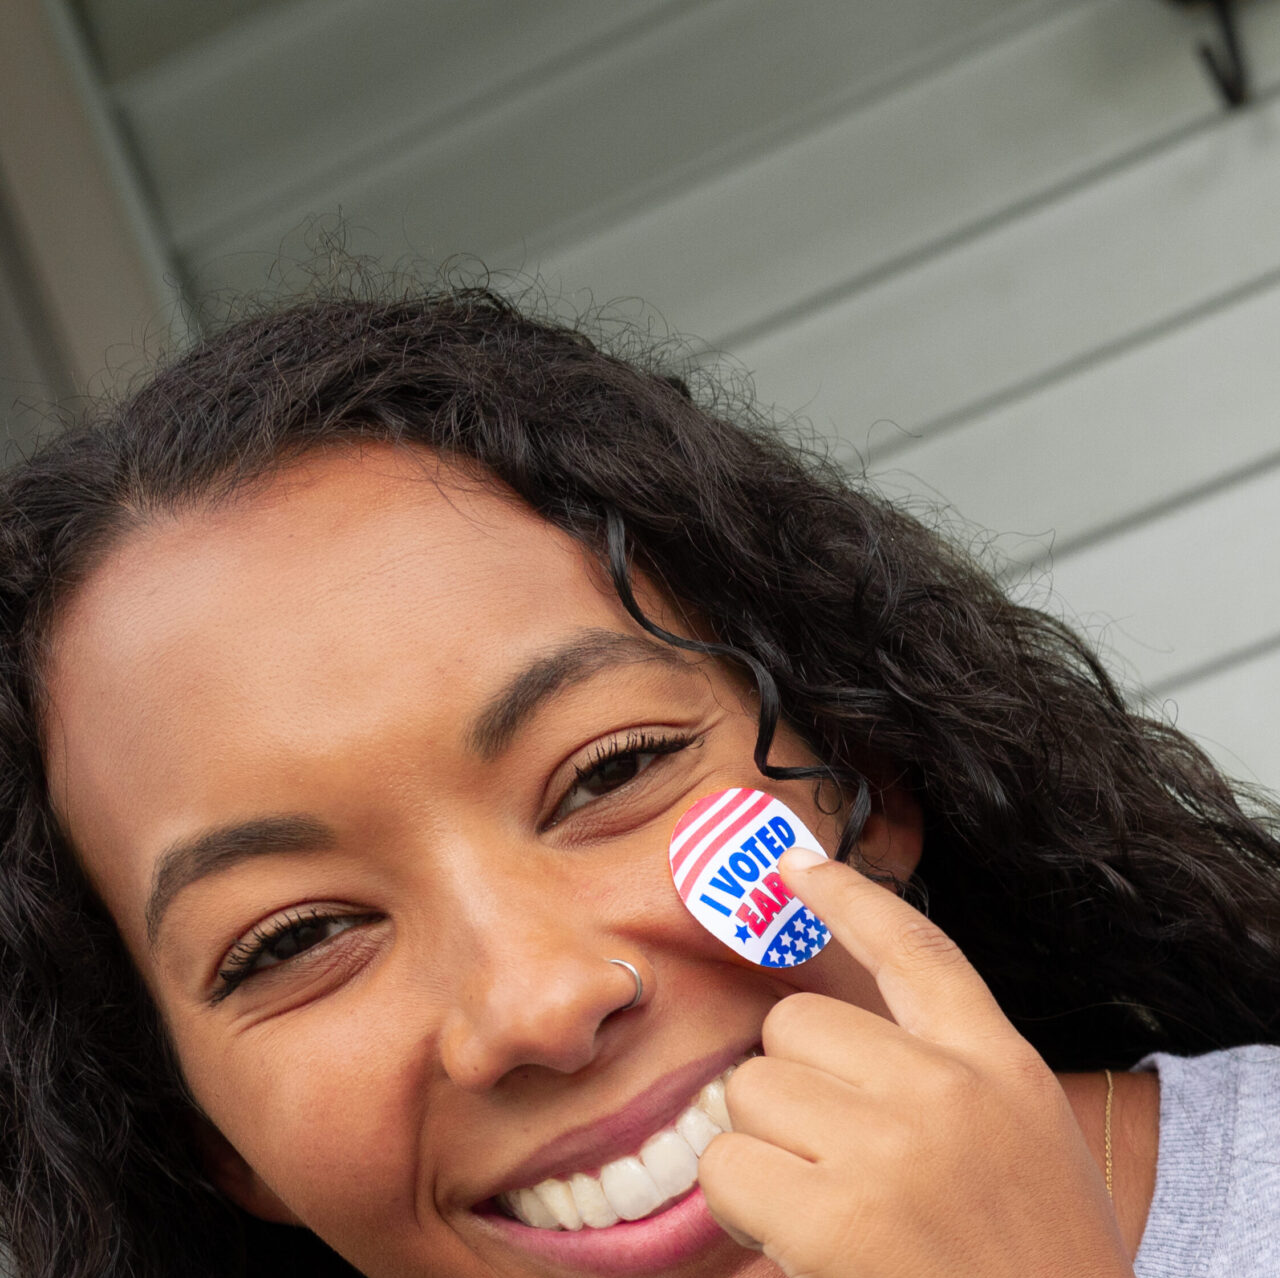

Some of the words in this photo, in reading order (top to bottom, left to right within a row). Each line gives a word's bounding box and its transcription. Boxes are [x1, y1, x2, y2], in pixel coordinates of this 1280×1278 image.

[708, 816, 796, 899] VOTED
[699, 893, 732, 917] I
[735, 871, 796, 939] EAR
